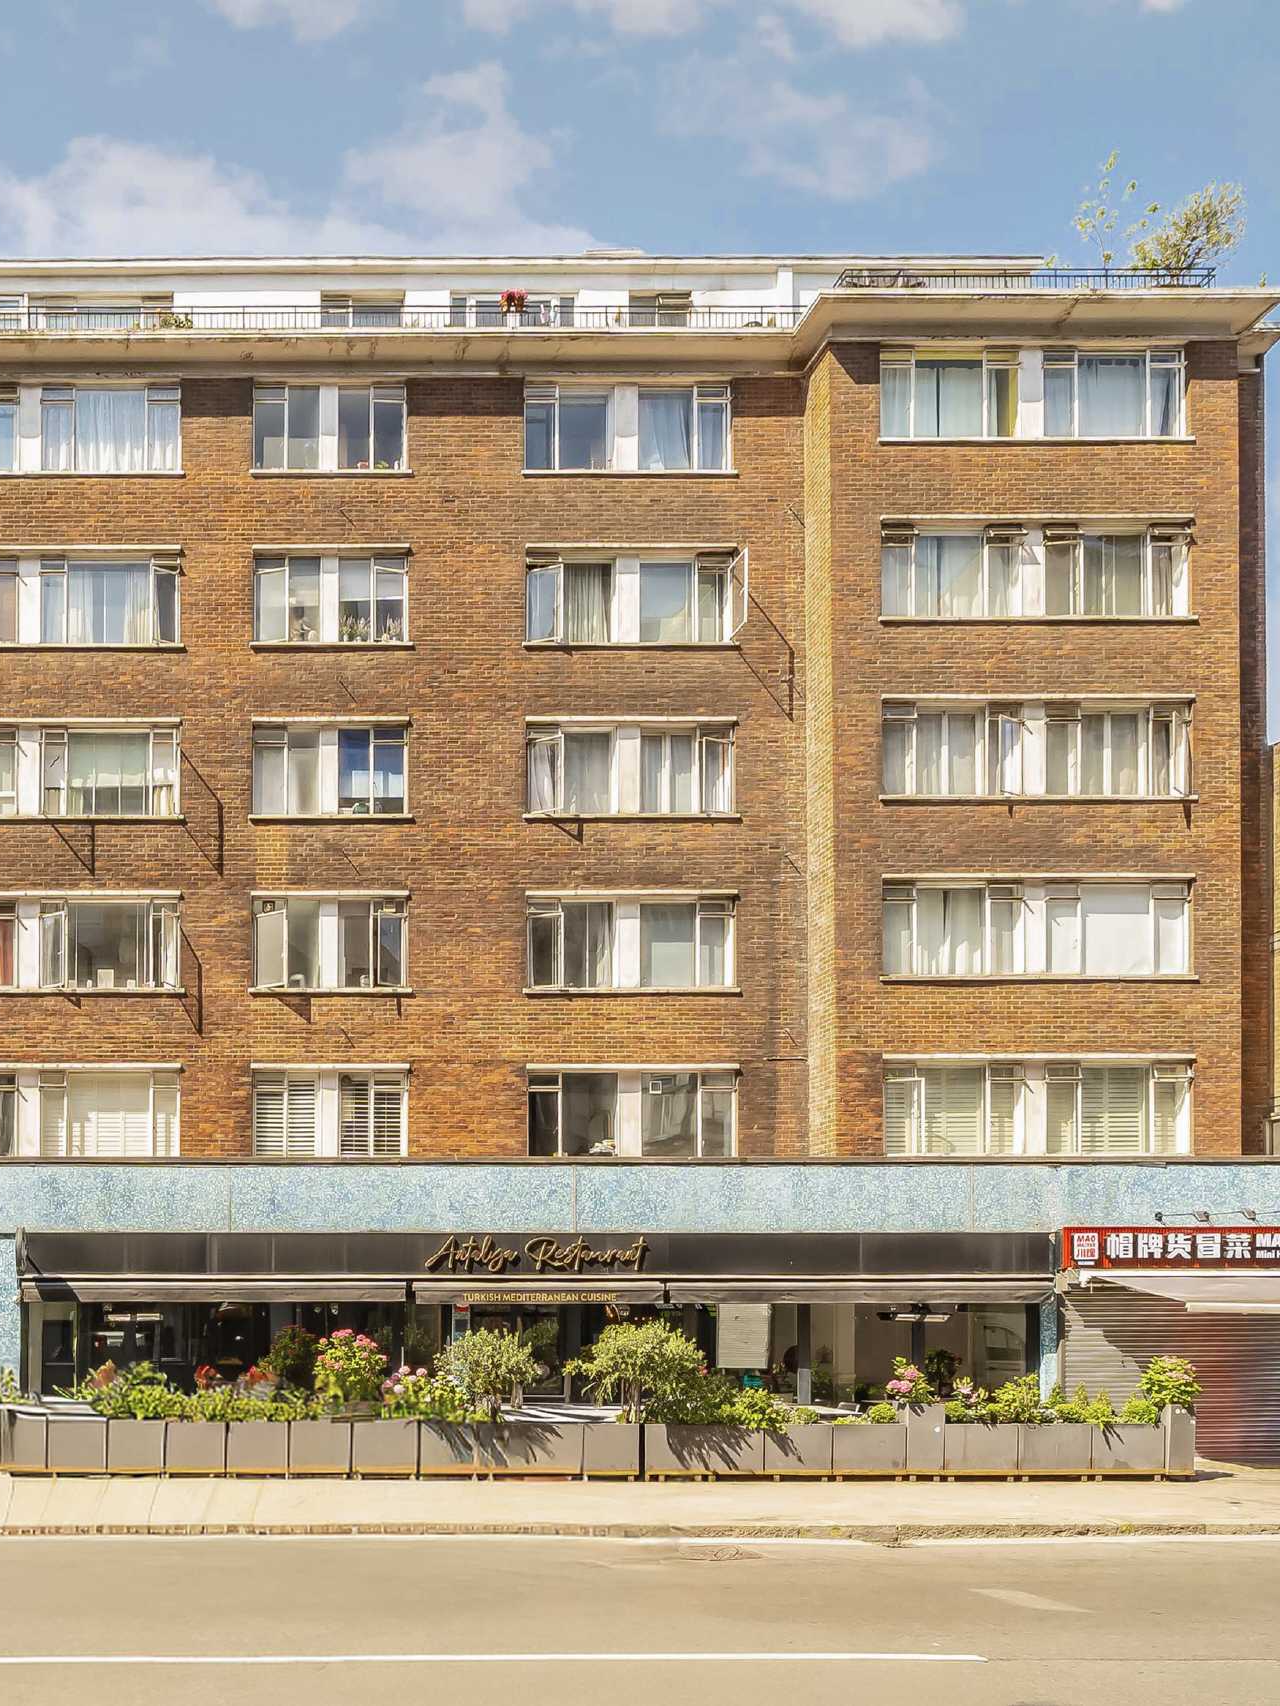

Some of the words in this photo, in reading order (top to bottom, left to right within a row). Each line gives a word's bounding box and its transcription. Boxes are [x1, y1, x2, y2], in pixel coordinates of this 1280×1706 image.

[425, 1235, 518, 1272] Antalya
[524, 1236, 648, 1271] Restaurant
[1106, 1233, 1252, 1259] 帽牌货冒菜
[463, 1293, 500, 1302] TURKISH
[502, 1293, 579, 1302] MEDITERRANEAN
[581, 1293, 617, 1302] CUISINE
